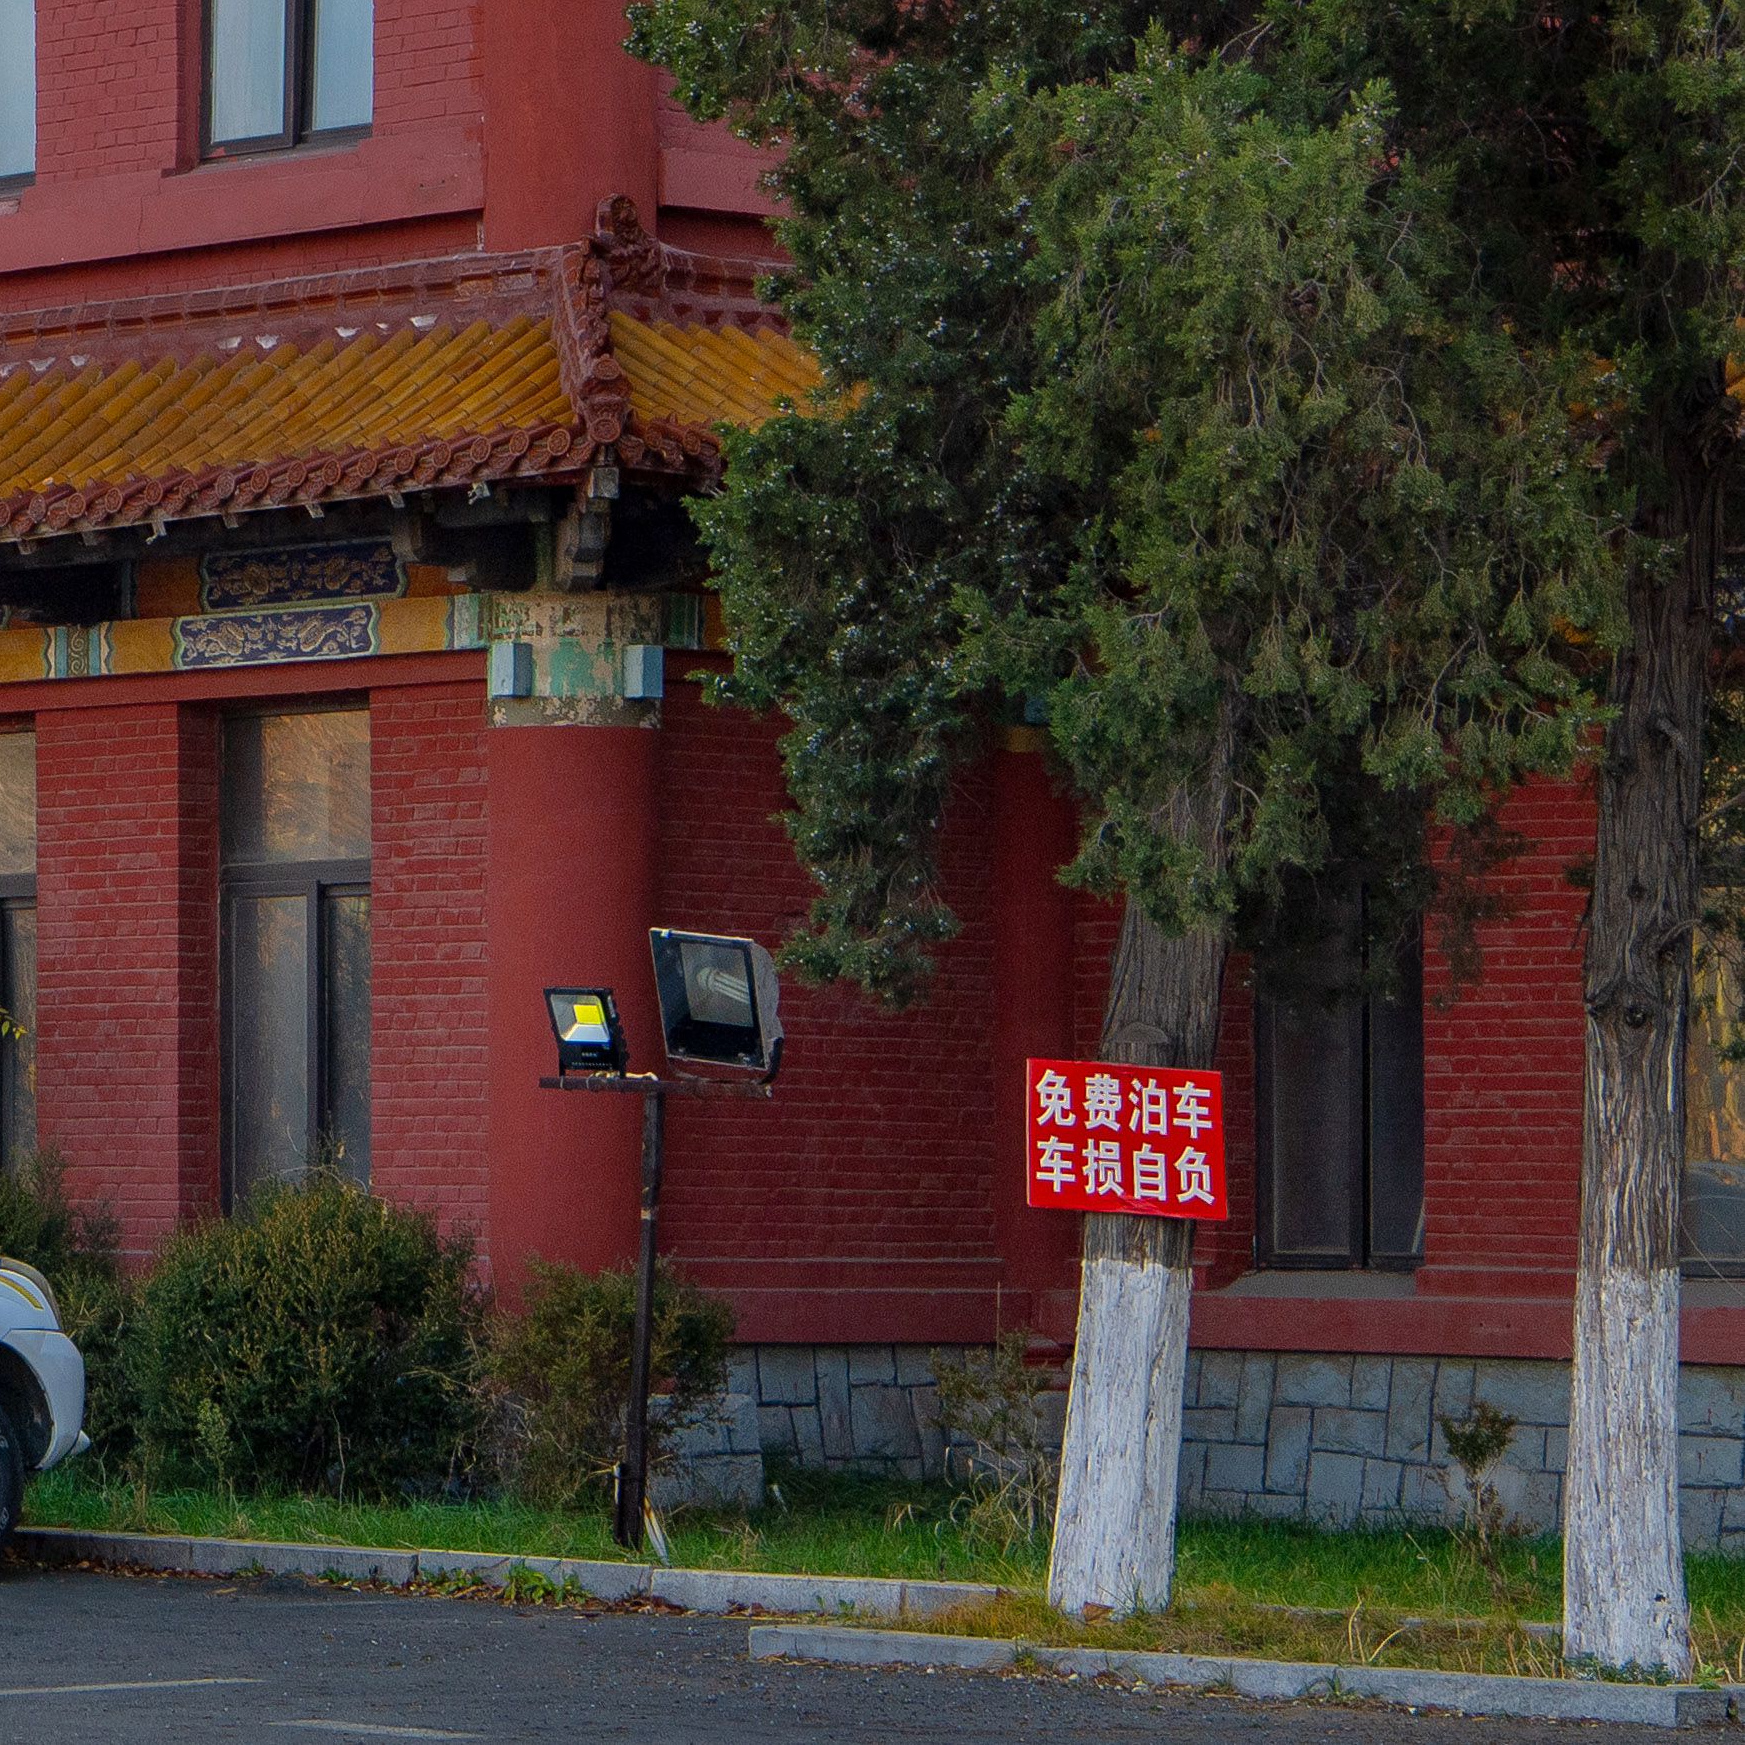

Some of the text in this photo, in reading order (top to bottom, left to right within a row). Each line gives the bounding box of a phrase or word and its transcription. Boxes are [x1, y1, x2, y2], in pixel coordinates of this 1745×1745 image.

[1035, 1069, 1213, 1139] 免费泊车
[1035, 1135, 1215, 1205] 车损自负
